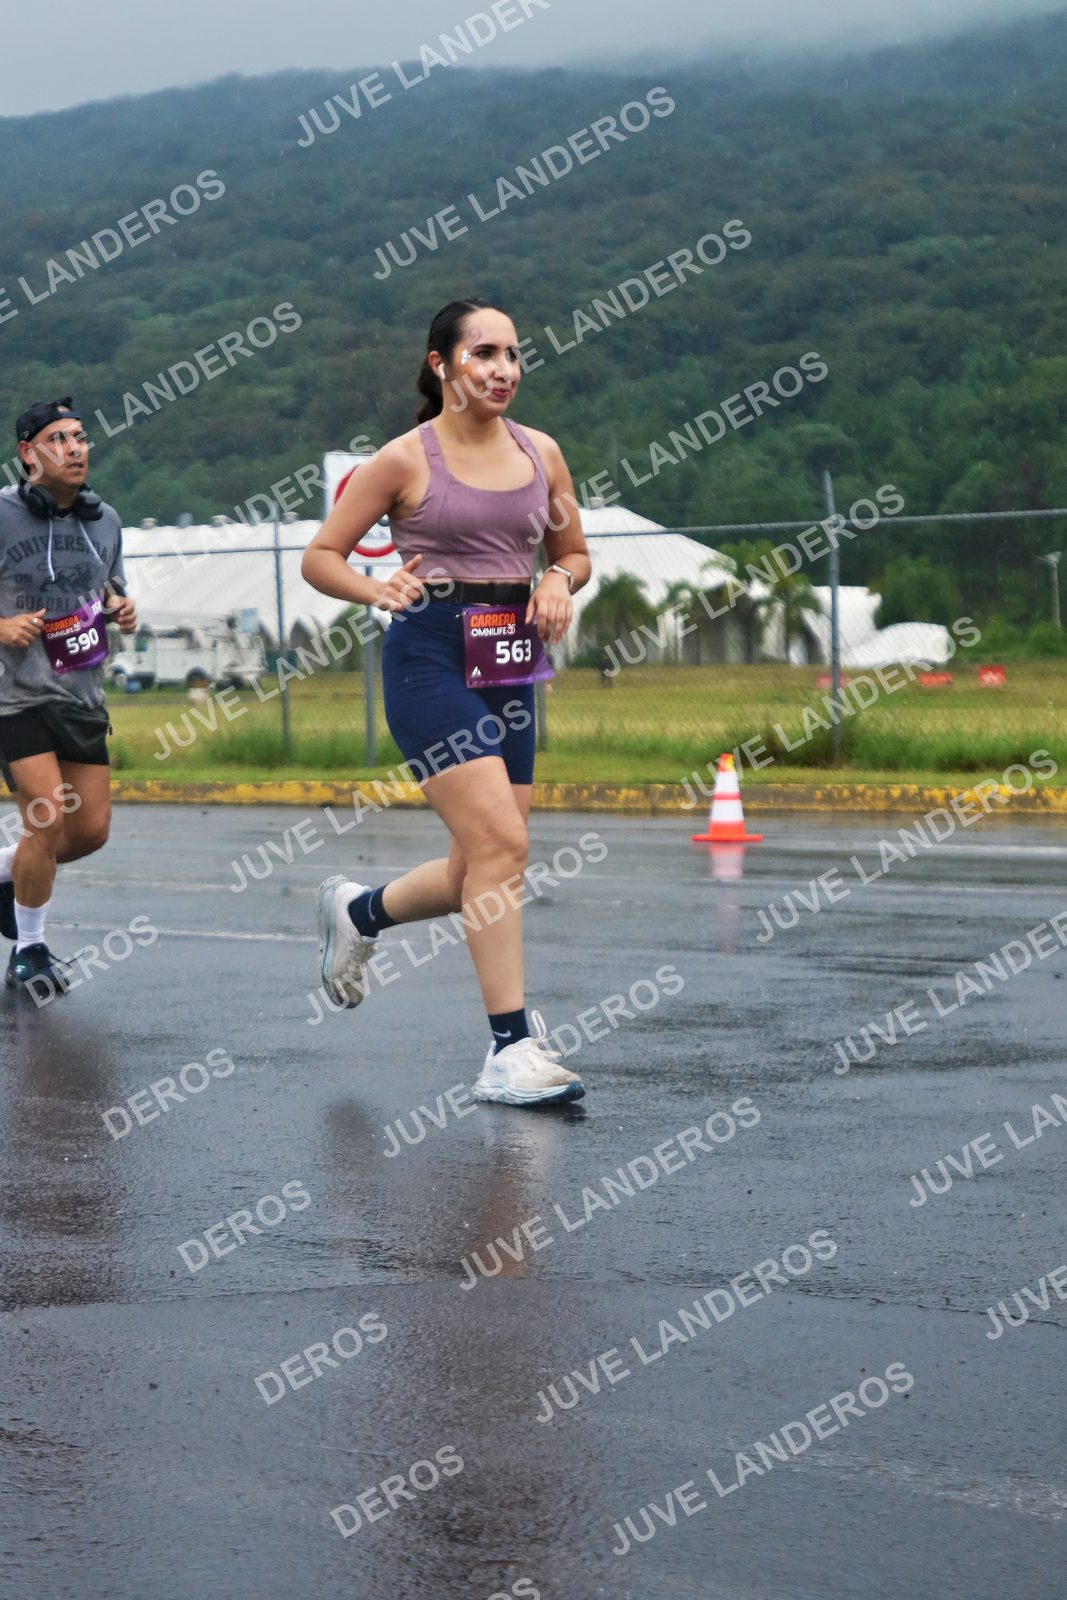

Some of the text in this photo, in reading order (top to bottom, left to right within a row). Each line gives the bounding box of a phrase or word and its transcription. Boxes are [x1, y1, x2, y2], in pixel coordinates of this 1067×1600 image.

[470, 613, 516, 627] CARRERA
[66, 627, 99, 655] 590
[470, 626, 508, 637] OMNILIFE
[495, 638, 532, 664] 563
